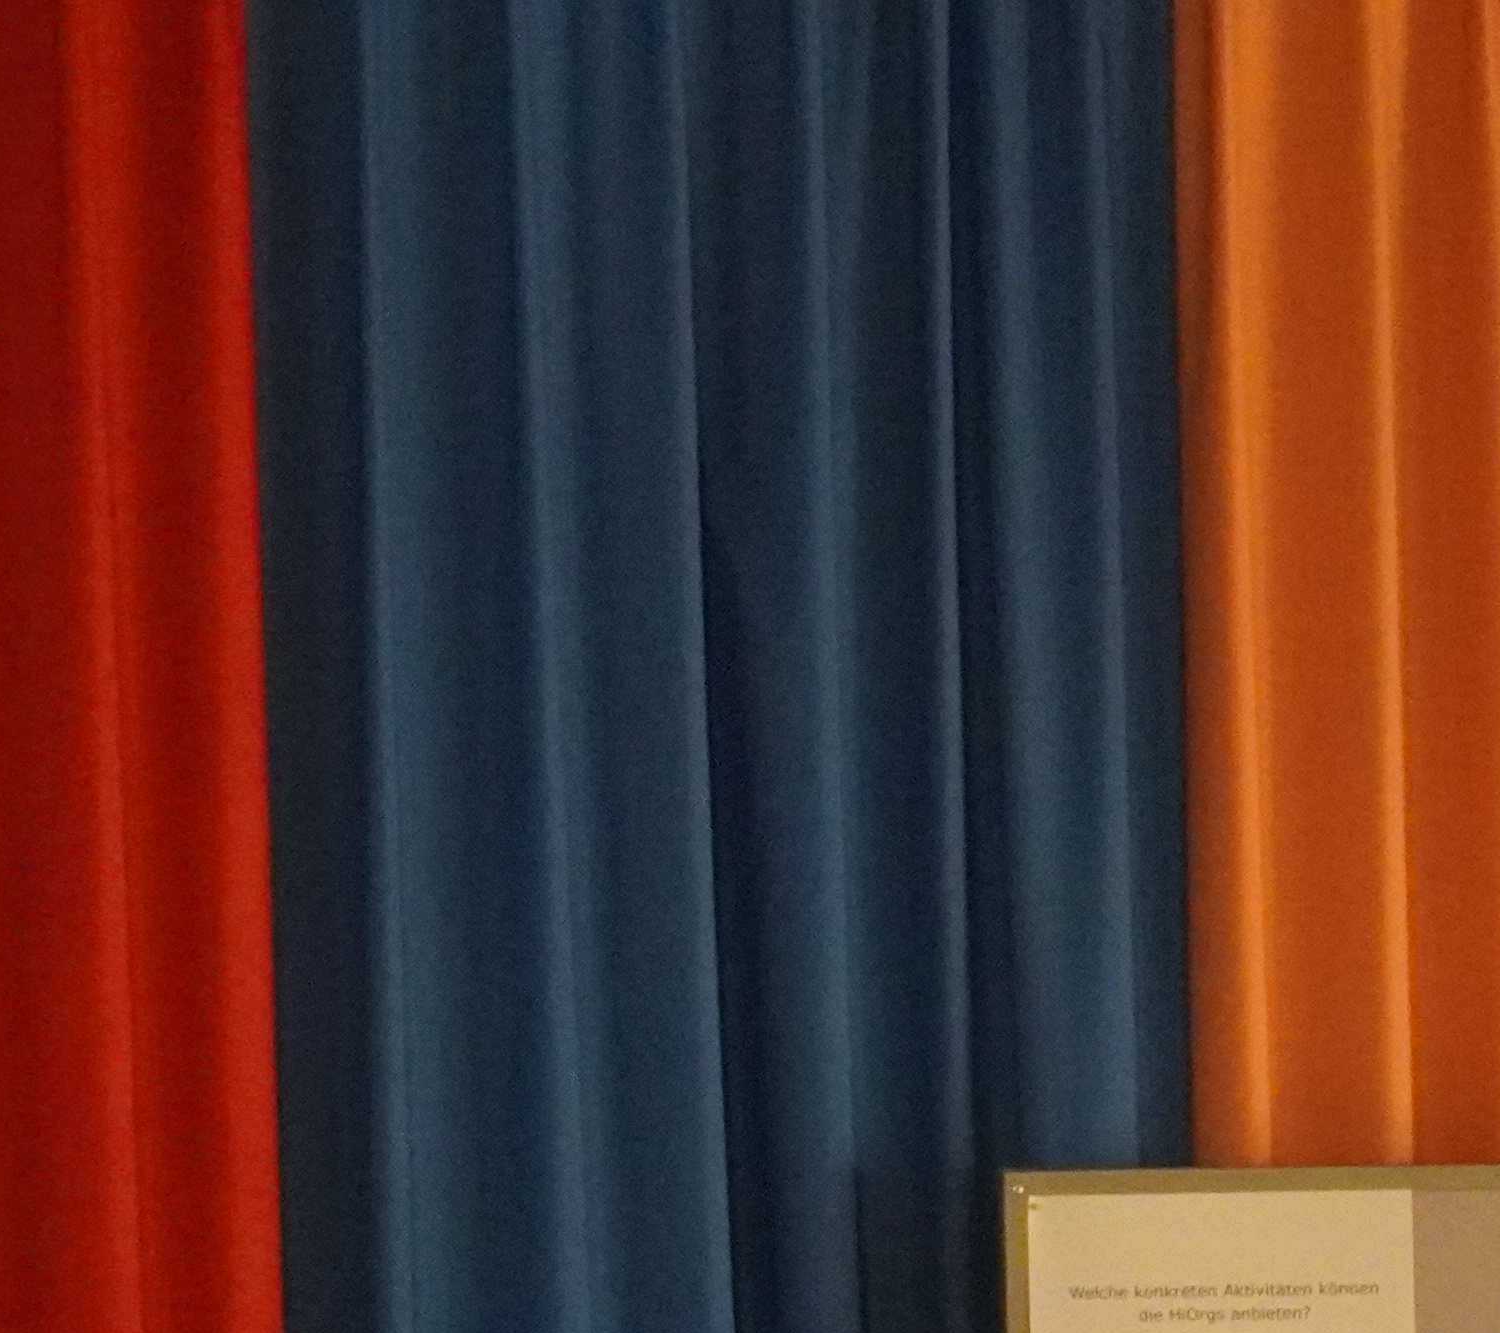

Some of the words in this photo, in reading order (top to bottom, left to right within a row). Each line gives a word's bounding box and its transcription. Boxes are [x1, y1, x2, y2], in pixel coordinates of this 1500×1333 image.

[1069, 1285, 1127, 1301] Welche
[1133, 1284, 1217, 1299] konkreten
[1223, 1281, 1312, 1298] Aktivitäten
[1317, 1280, 1380, 1296] können
[1139, 1307, 1163, 1322] die
[1168, 1307, 1225, 1324] HiOrgs
[1230, 1304, 1311, 1321] anbieten?
